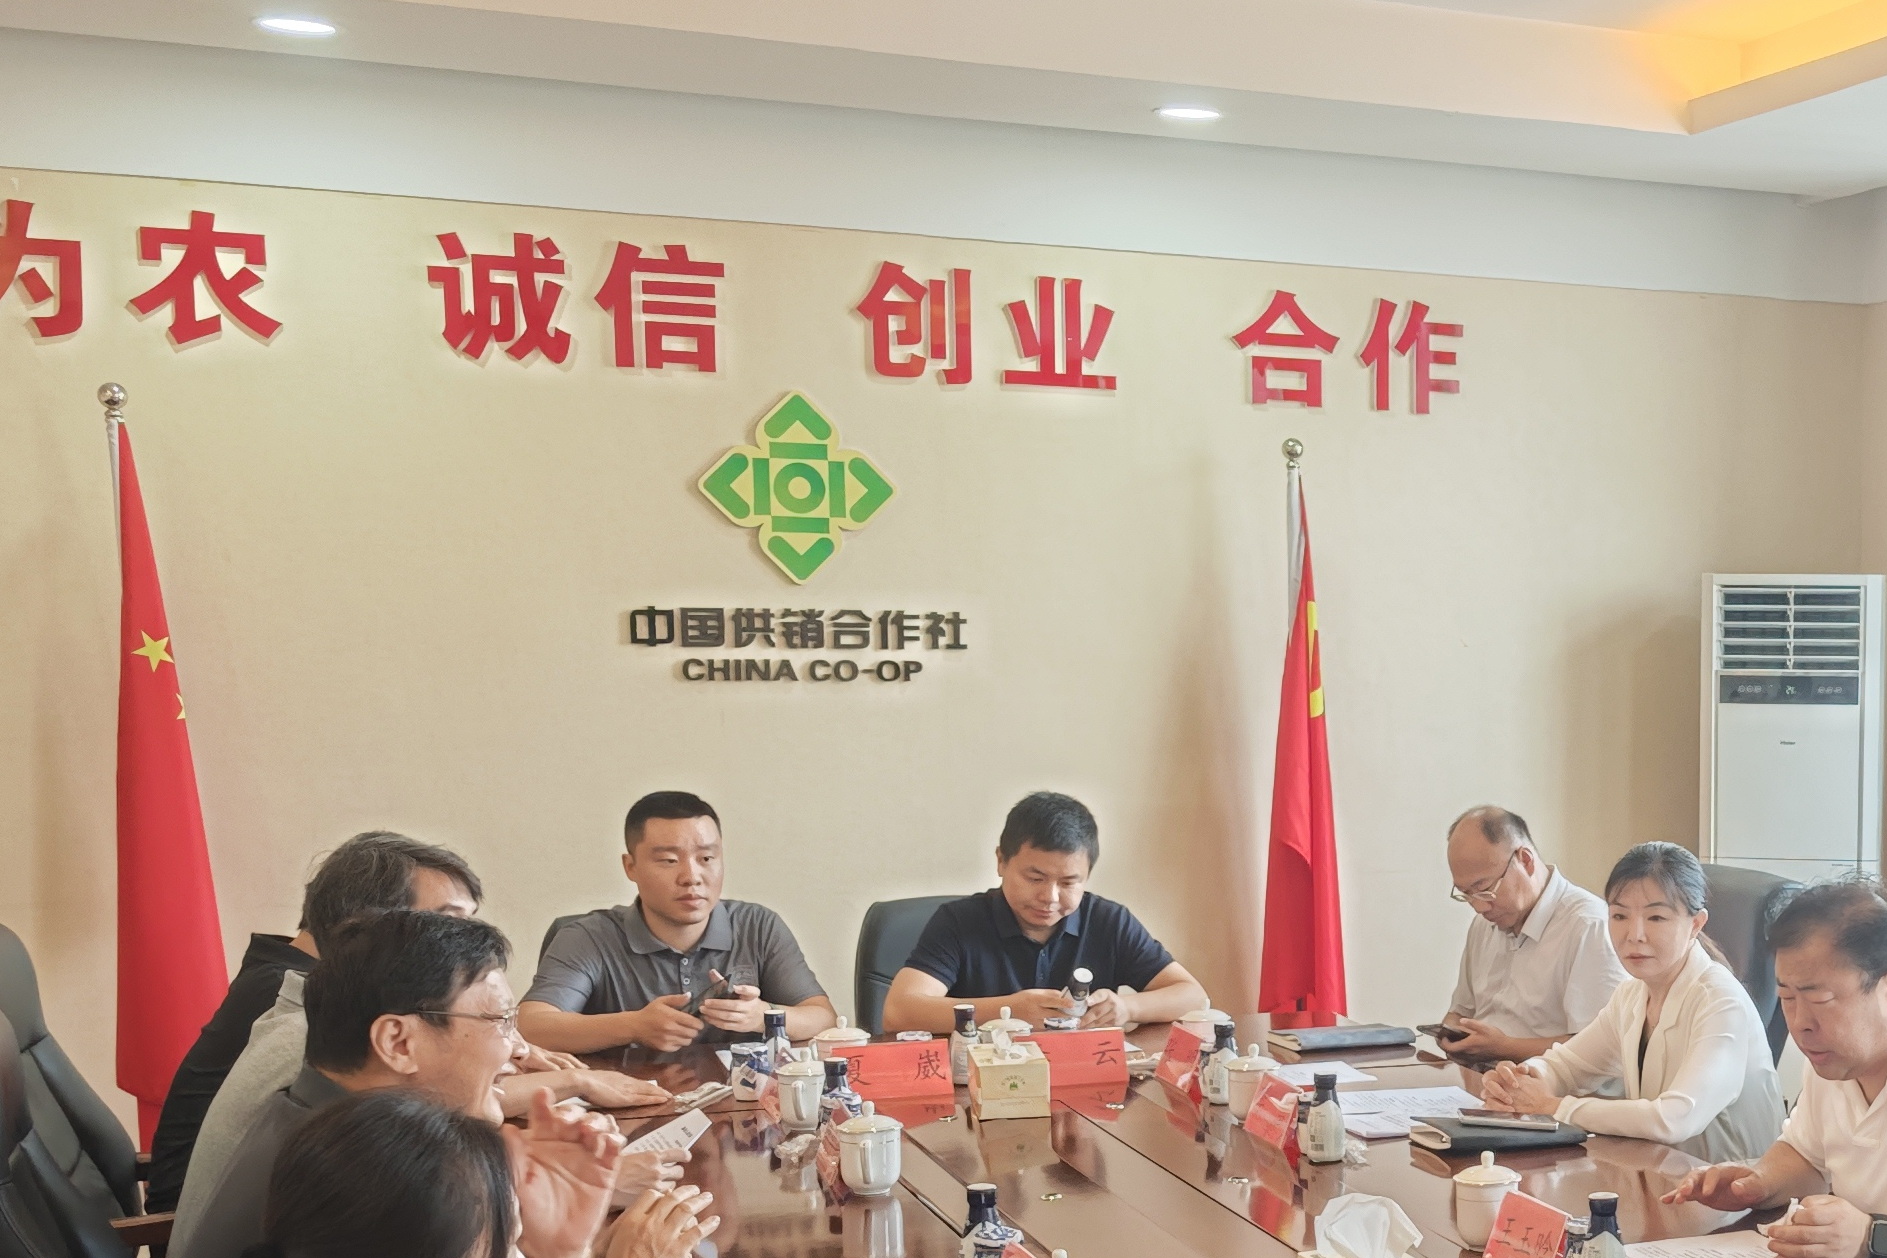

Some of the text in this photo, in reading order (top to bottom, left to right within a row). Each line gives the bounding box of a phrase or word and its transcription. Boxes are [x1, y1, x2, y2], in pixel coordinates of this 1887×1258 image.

[0, 199, 1464, 415] 为农 诚信 创业 合作
[629, 605, 968, 650] 中国供销合作社
[681, 658, 924, 684] CHINA CO-OP
